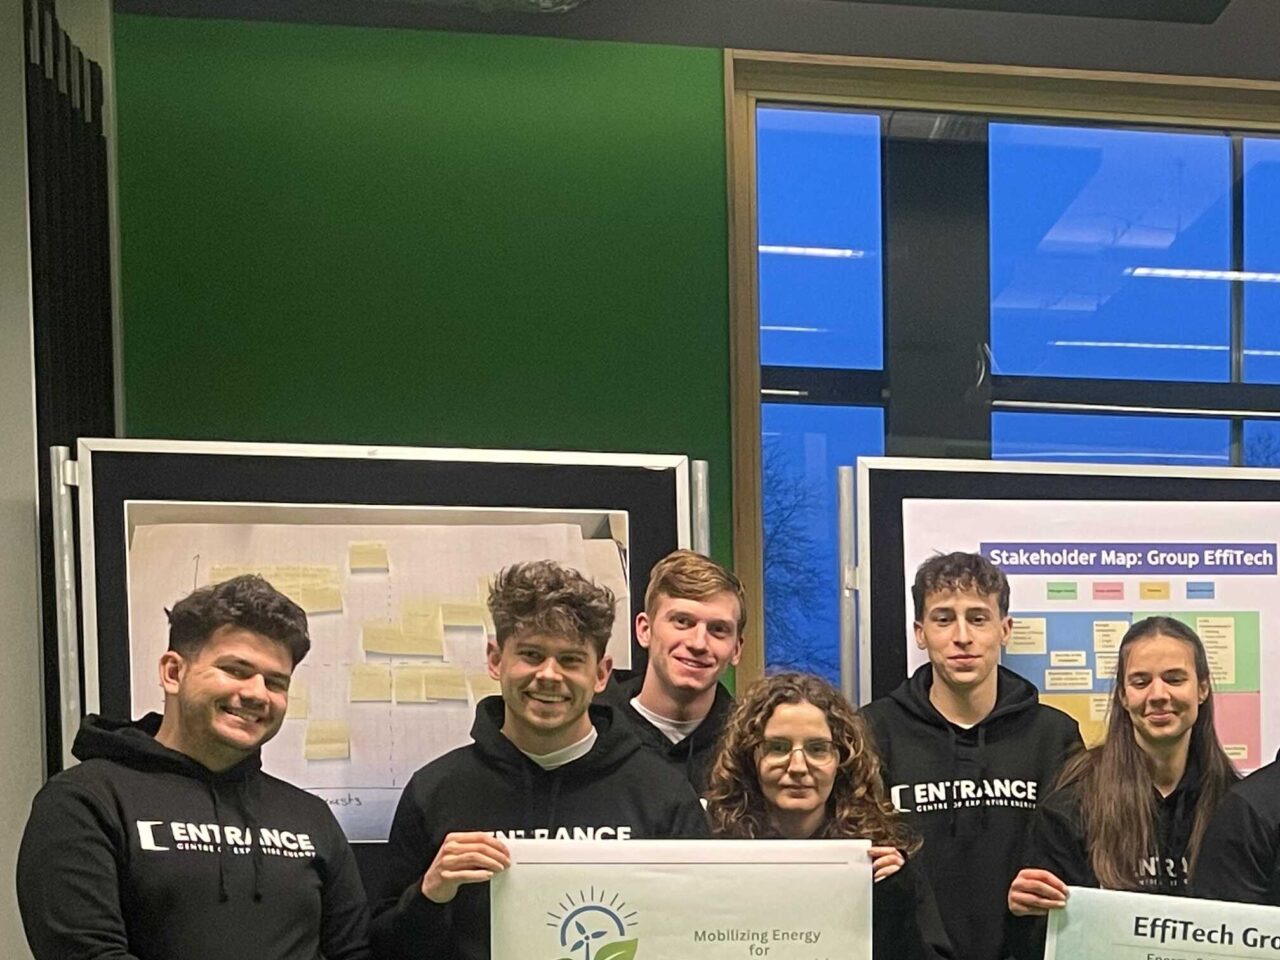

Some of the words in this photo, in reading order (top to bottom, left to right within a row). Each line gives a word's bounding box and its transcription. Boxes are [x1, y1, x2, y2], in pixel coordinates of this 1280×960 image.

[990, 549, 1097, 567] Stakeholder
[1101, 549, 1143, 570] Map:
[1147, 549, 1200, 569] Group
[1204, 548, 1273, 566] EffiTech
[914, 779, 1038, 804] ENTRANCE
[694, 929, 769, 944] Mobilizing
[772, 929, 821, 944] Energy
[1134, 916, 1234, 946] EffiTech
[749, 943, 771, 957] for
